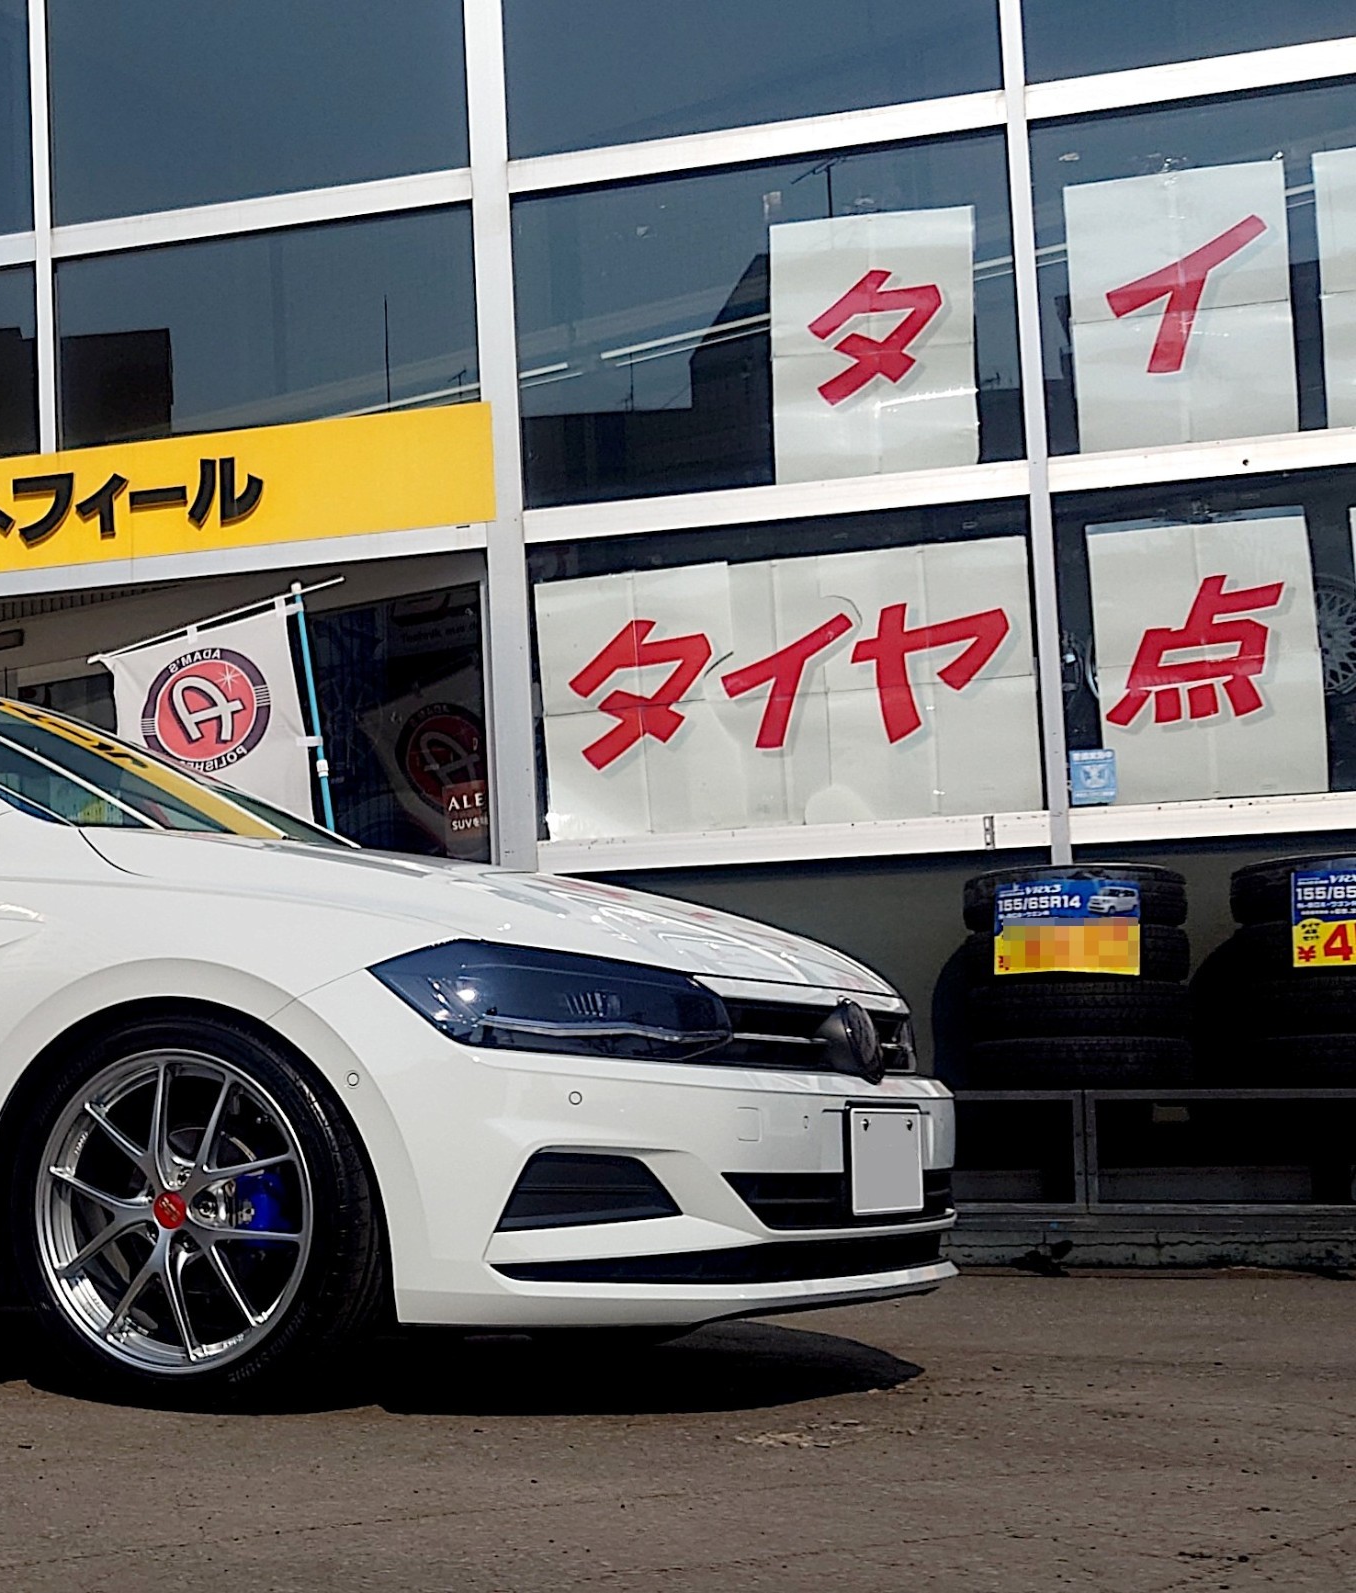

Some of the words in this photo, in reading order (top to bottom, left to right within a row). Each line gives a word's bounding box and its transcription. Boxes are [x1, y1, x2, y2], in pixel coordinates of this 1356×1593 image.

[807, 268, 944, 407] タ
[1104, 213, 1268, 375] イ
[567, 602, 1011, 772] タイヤ
[1105, 573, 1286, 728] 点
[997, 895, 1081, 913] 155/65R14
